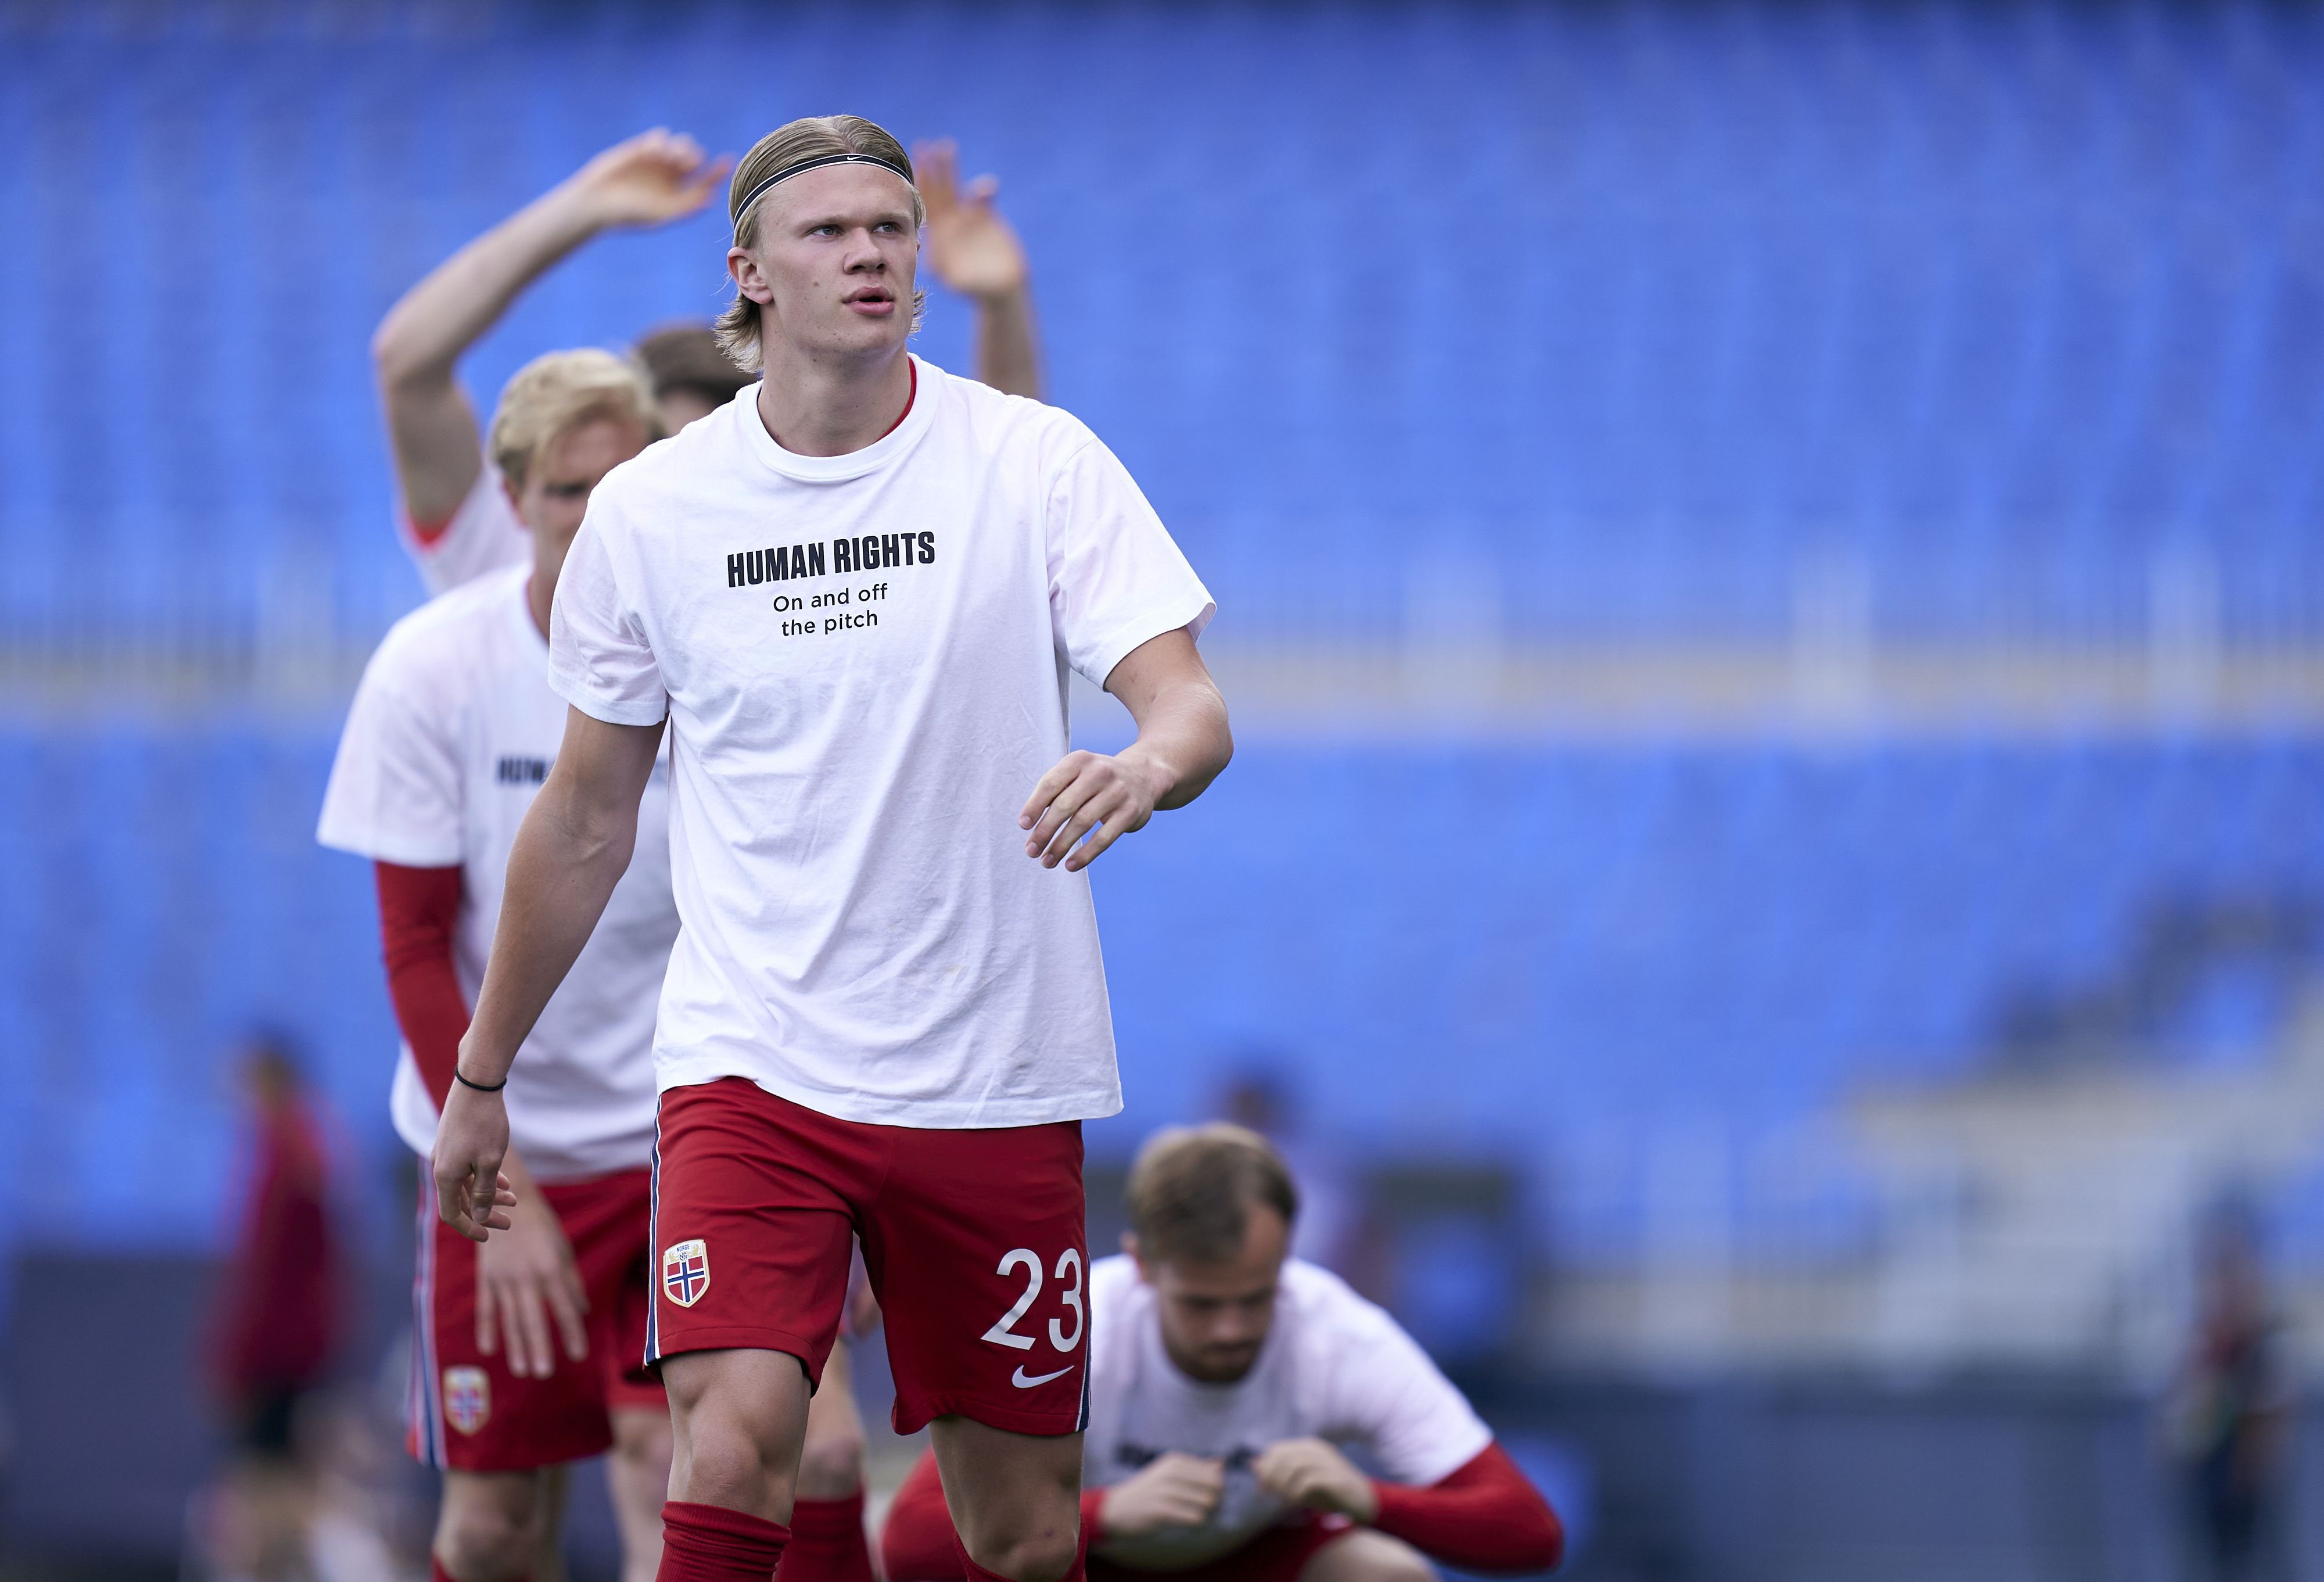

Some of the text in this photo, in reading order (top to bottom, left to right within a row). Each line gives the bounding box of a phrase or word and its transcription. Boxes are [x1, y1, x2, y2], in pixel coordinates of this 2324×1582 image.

[727, 531, 935, 588] HUMAN RIGHTS
[773, 583, 888, 612] On and off
[781, 609, 878, 637] the pitch
[676, 1244, 690, 1253] NORGE
[980, 1248, 1084, 1353] 23
